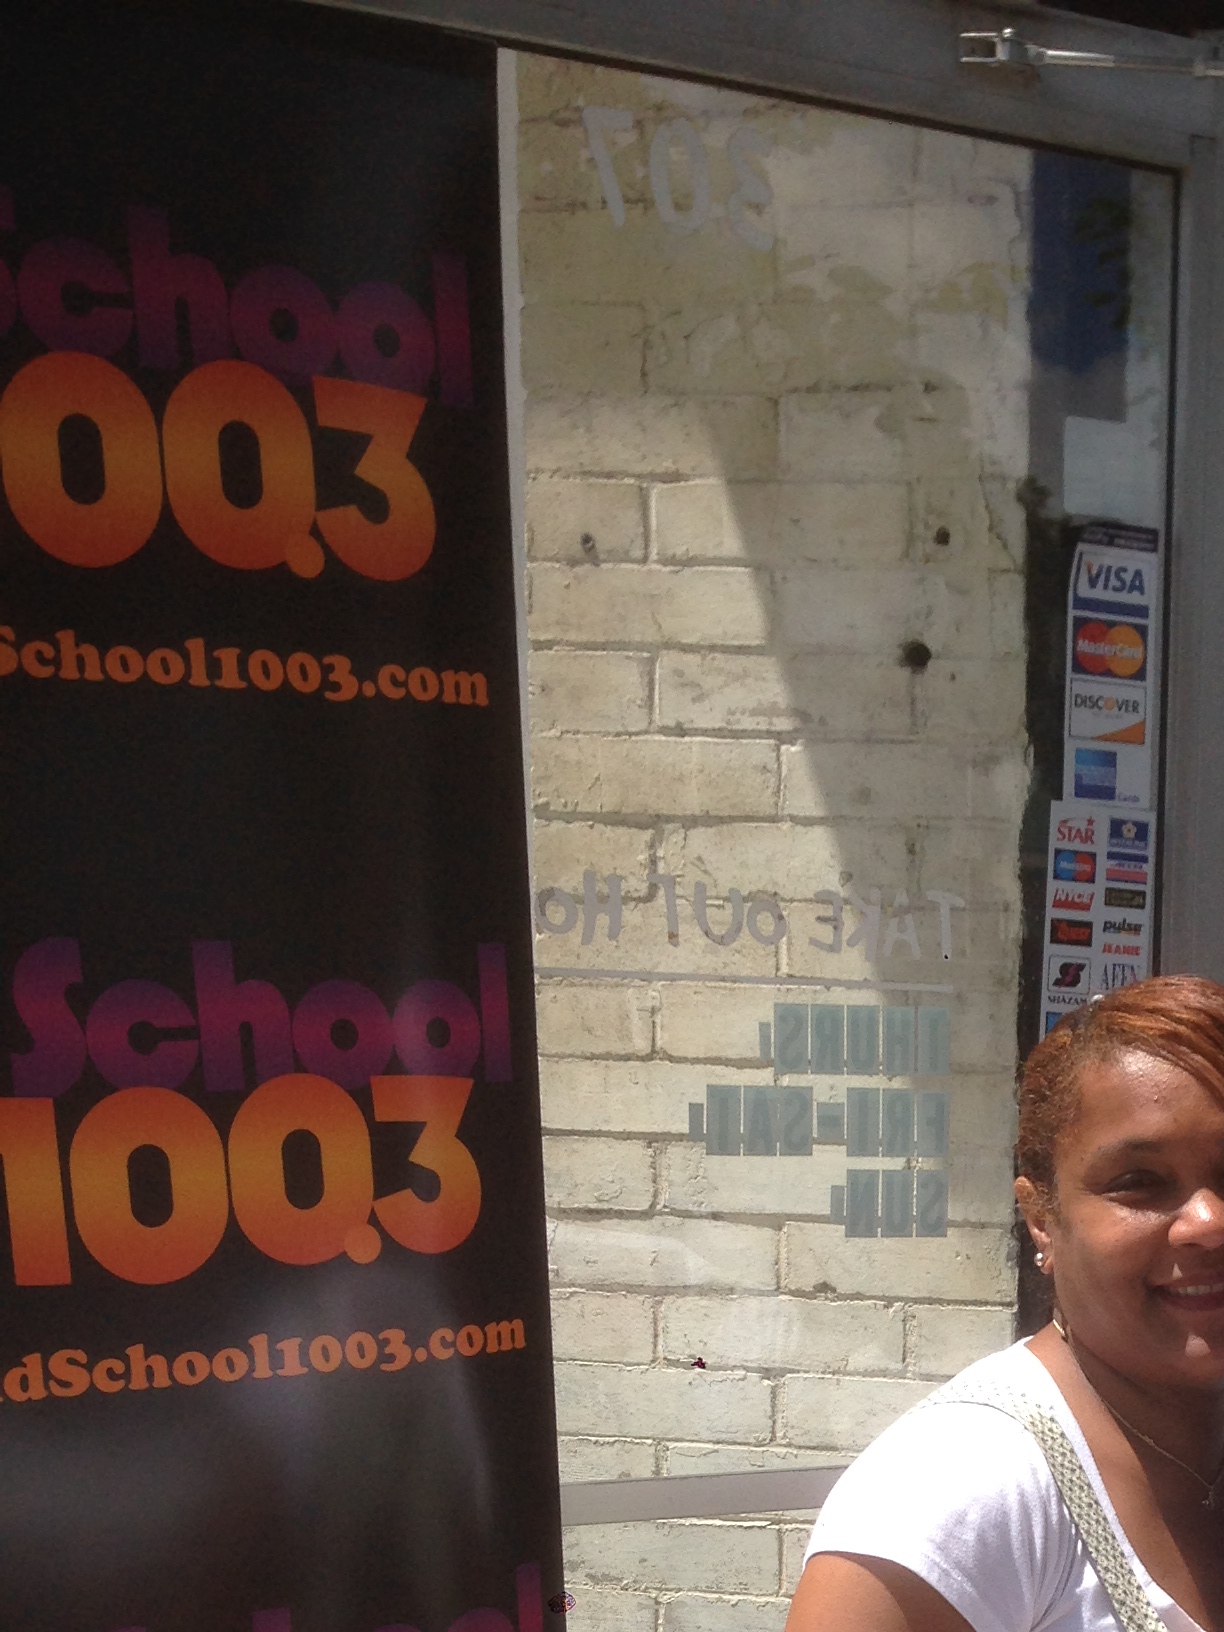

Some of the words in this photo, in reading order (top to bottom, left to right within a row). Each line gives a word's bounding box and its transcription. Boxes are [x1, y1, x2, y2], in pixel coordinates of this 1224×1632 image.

[0, 187, 474, 408] chool
[1086, 561, 1146, 596] VISA
[1074, 693, 1140, 715] DISCOVER
[1057, 824, 1095, 845] STAR
[10, 936, 512, 1100] School
[0, 1318, 526, 1403] dSchool1003.com
